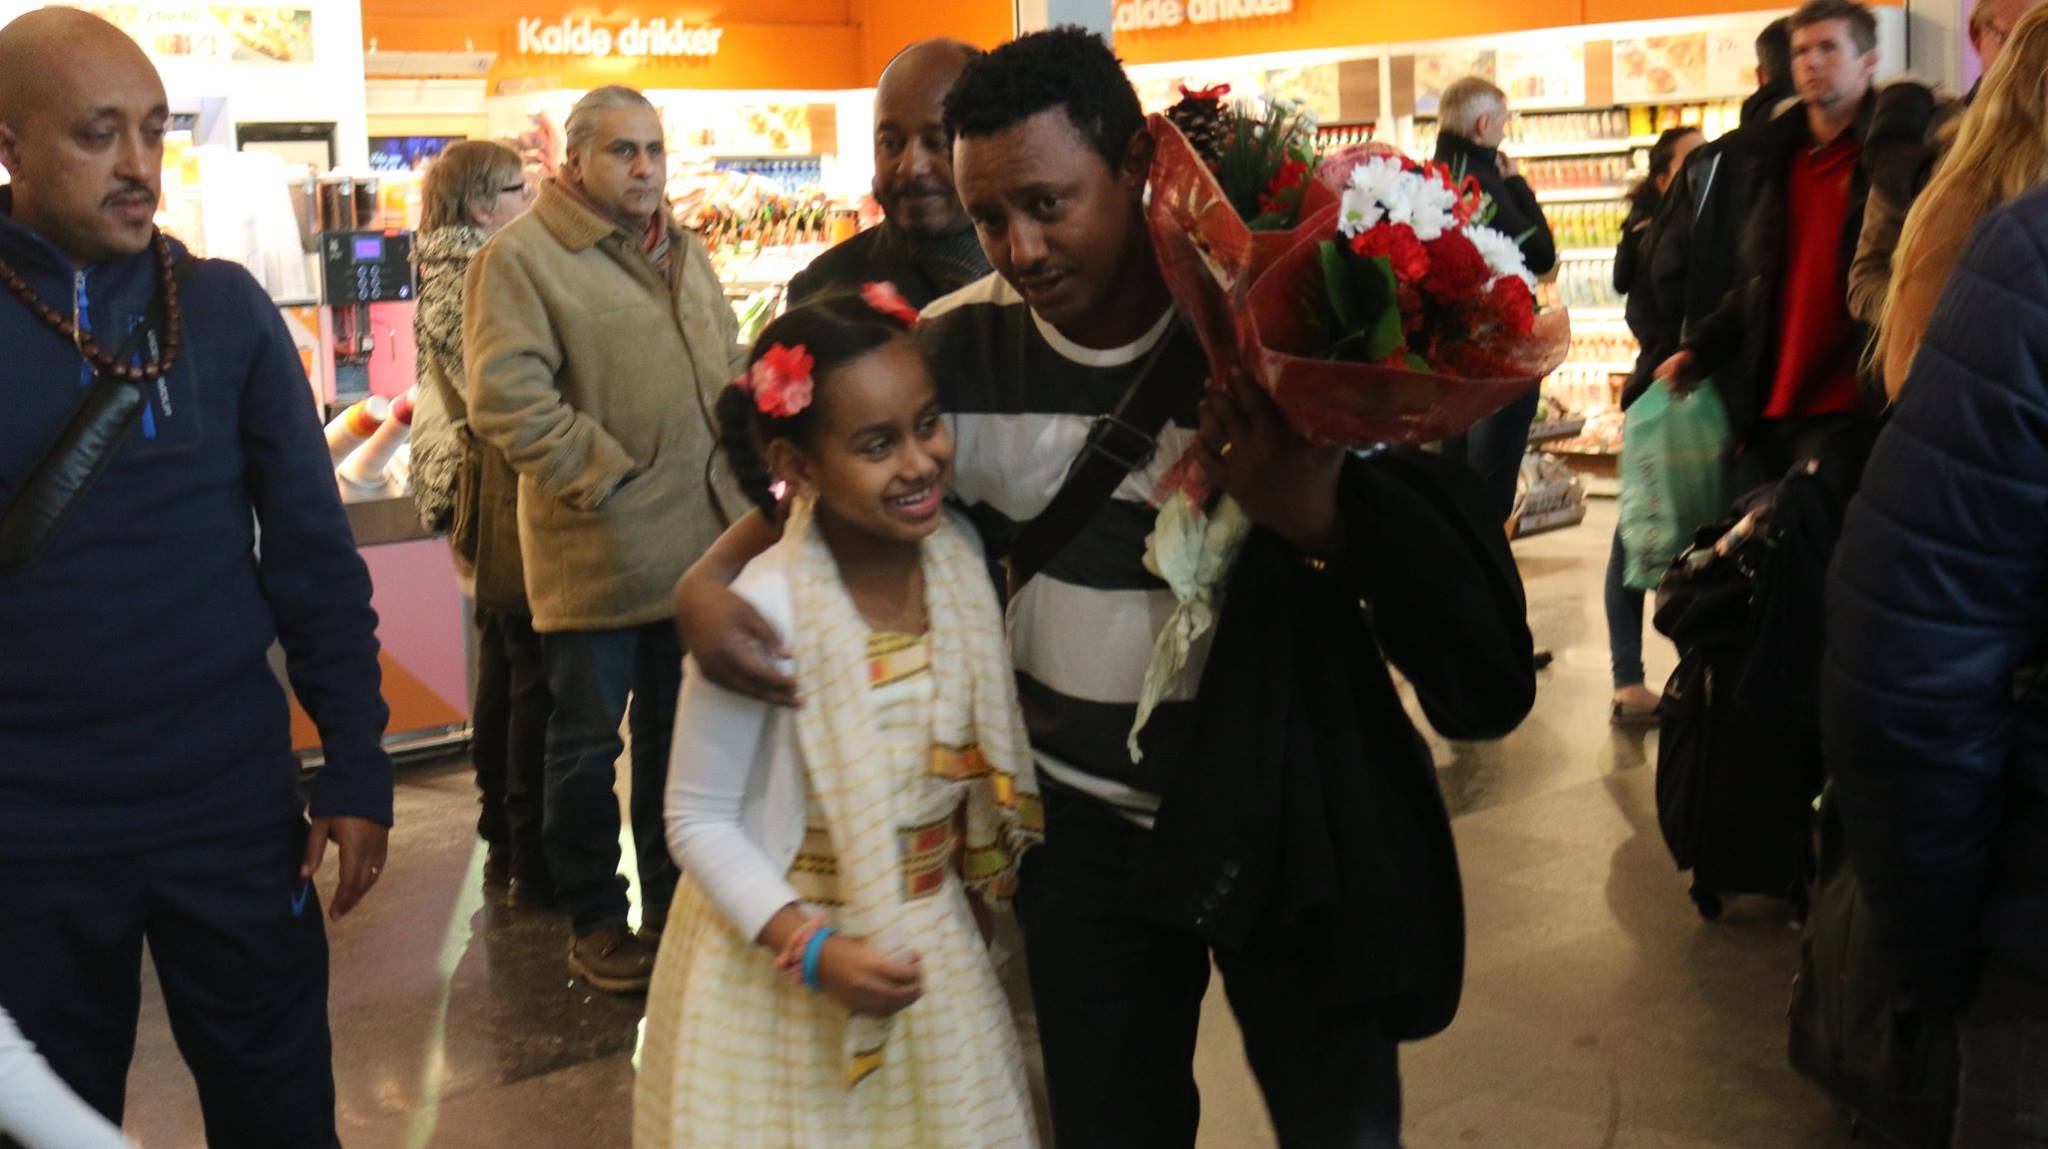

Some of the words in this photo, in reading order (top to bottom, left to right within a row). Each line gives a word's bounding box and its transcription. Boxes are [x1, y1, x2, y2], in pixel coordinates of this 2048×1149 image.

[1112, 0, 1184, 31] alde
[518, 16, 612, 56] Kalde
[619, 17, 723, 56] drikker
